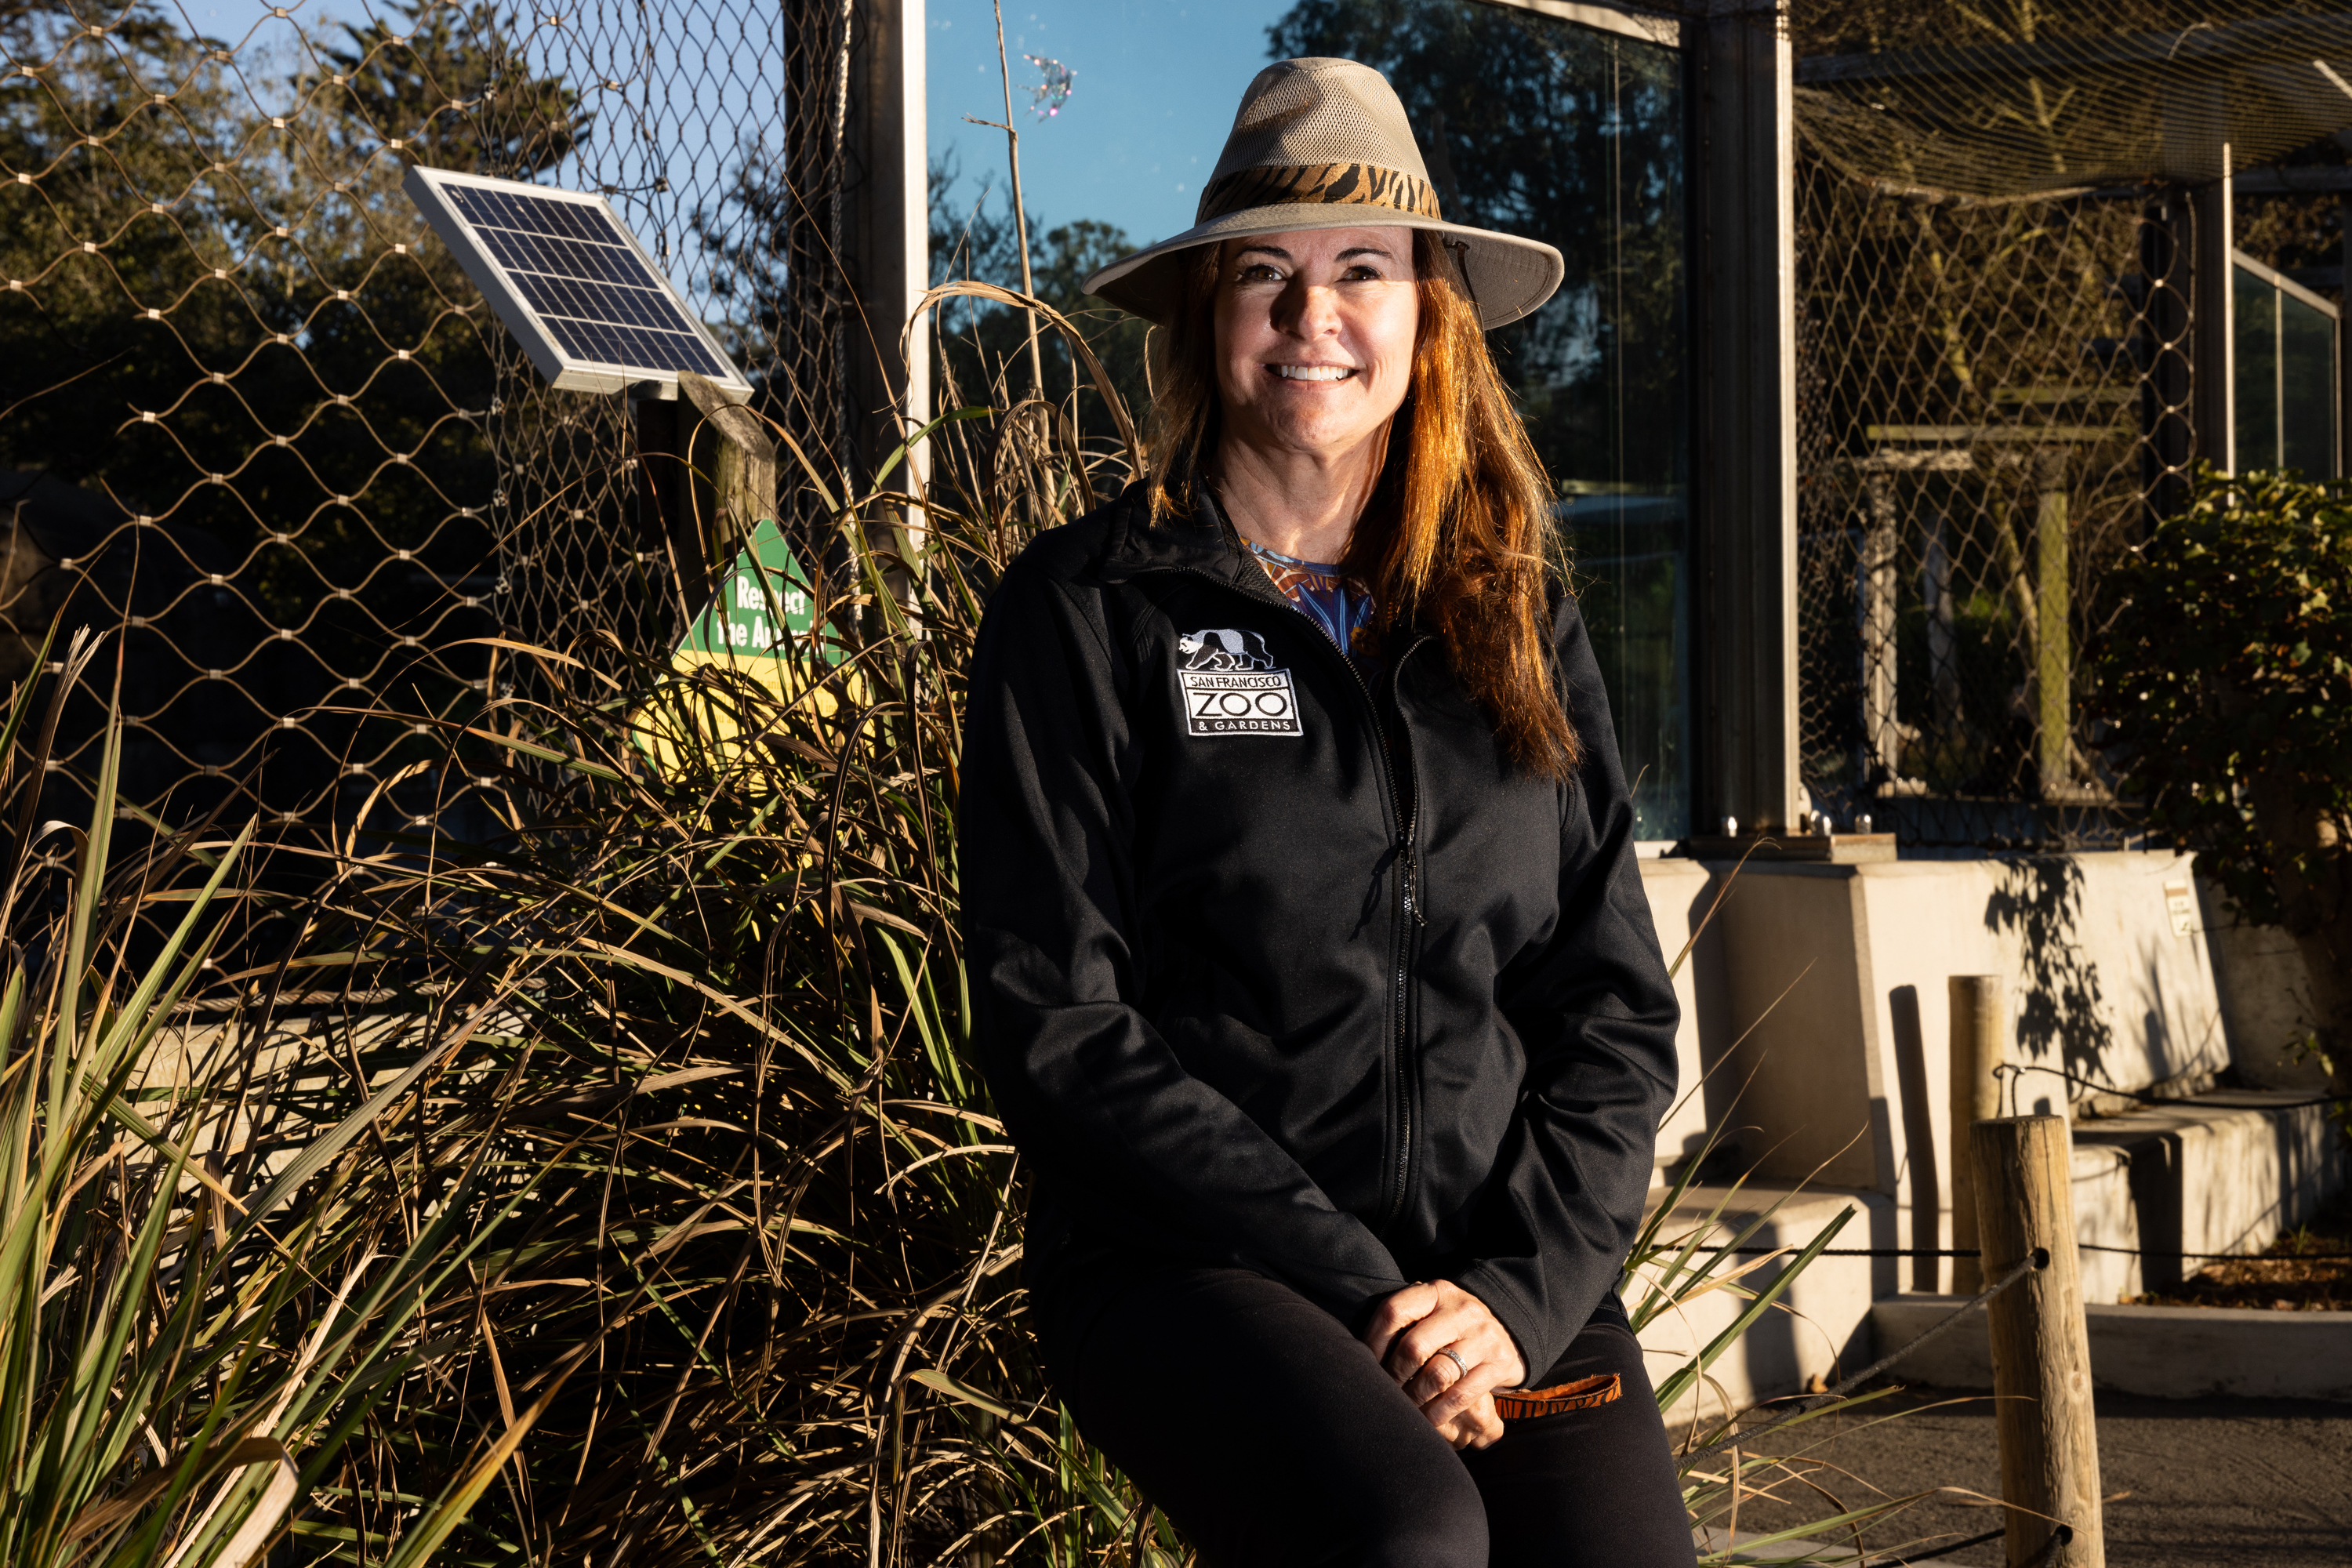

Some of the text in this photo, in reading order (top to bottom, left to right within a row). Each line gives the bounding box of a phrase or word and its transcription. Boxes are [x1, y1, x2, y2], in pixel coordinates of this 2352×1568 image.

[717, 611, 748, 647] the
[1190, 676, 1282, 688] SAN FRANCISCO
[1192, 692, 1287, 717] ZOO
[1198, 720, 1291, 731] & GARDENS
